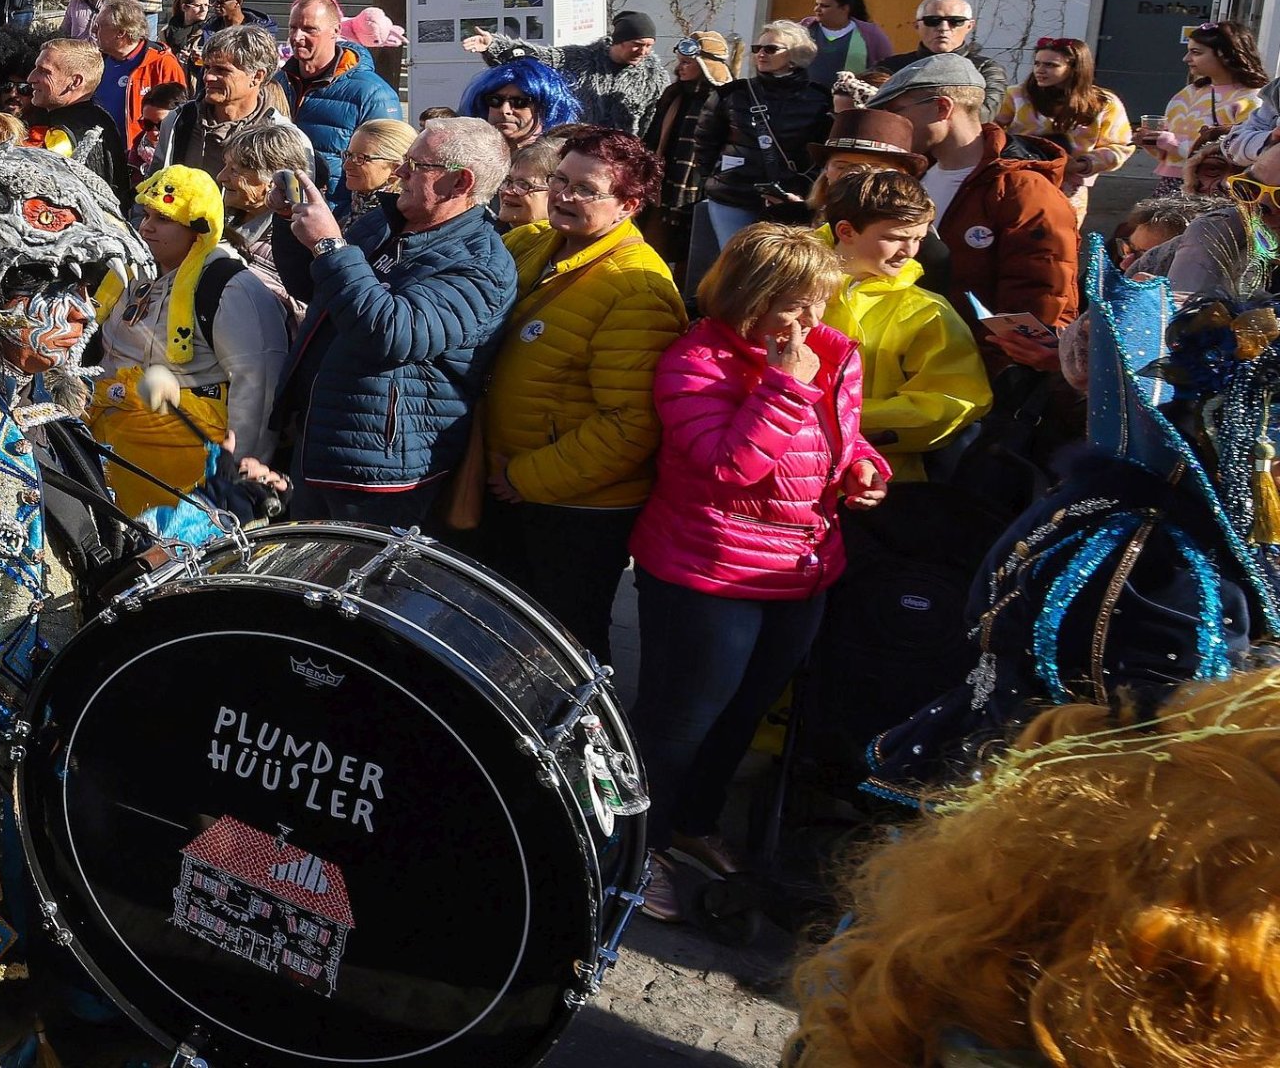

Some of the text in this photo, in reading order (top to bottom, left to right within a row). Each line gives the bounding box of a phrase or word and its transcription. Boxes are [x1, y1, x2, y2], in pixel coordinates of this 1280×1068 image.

[296, 664, 336, 683] REMO
[207, 739, 374, 833] HÜÜSLER
[213, 705, 384, 800] PLUNDER
